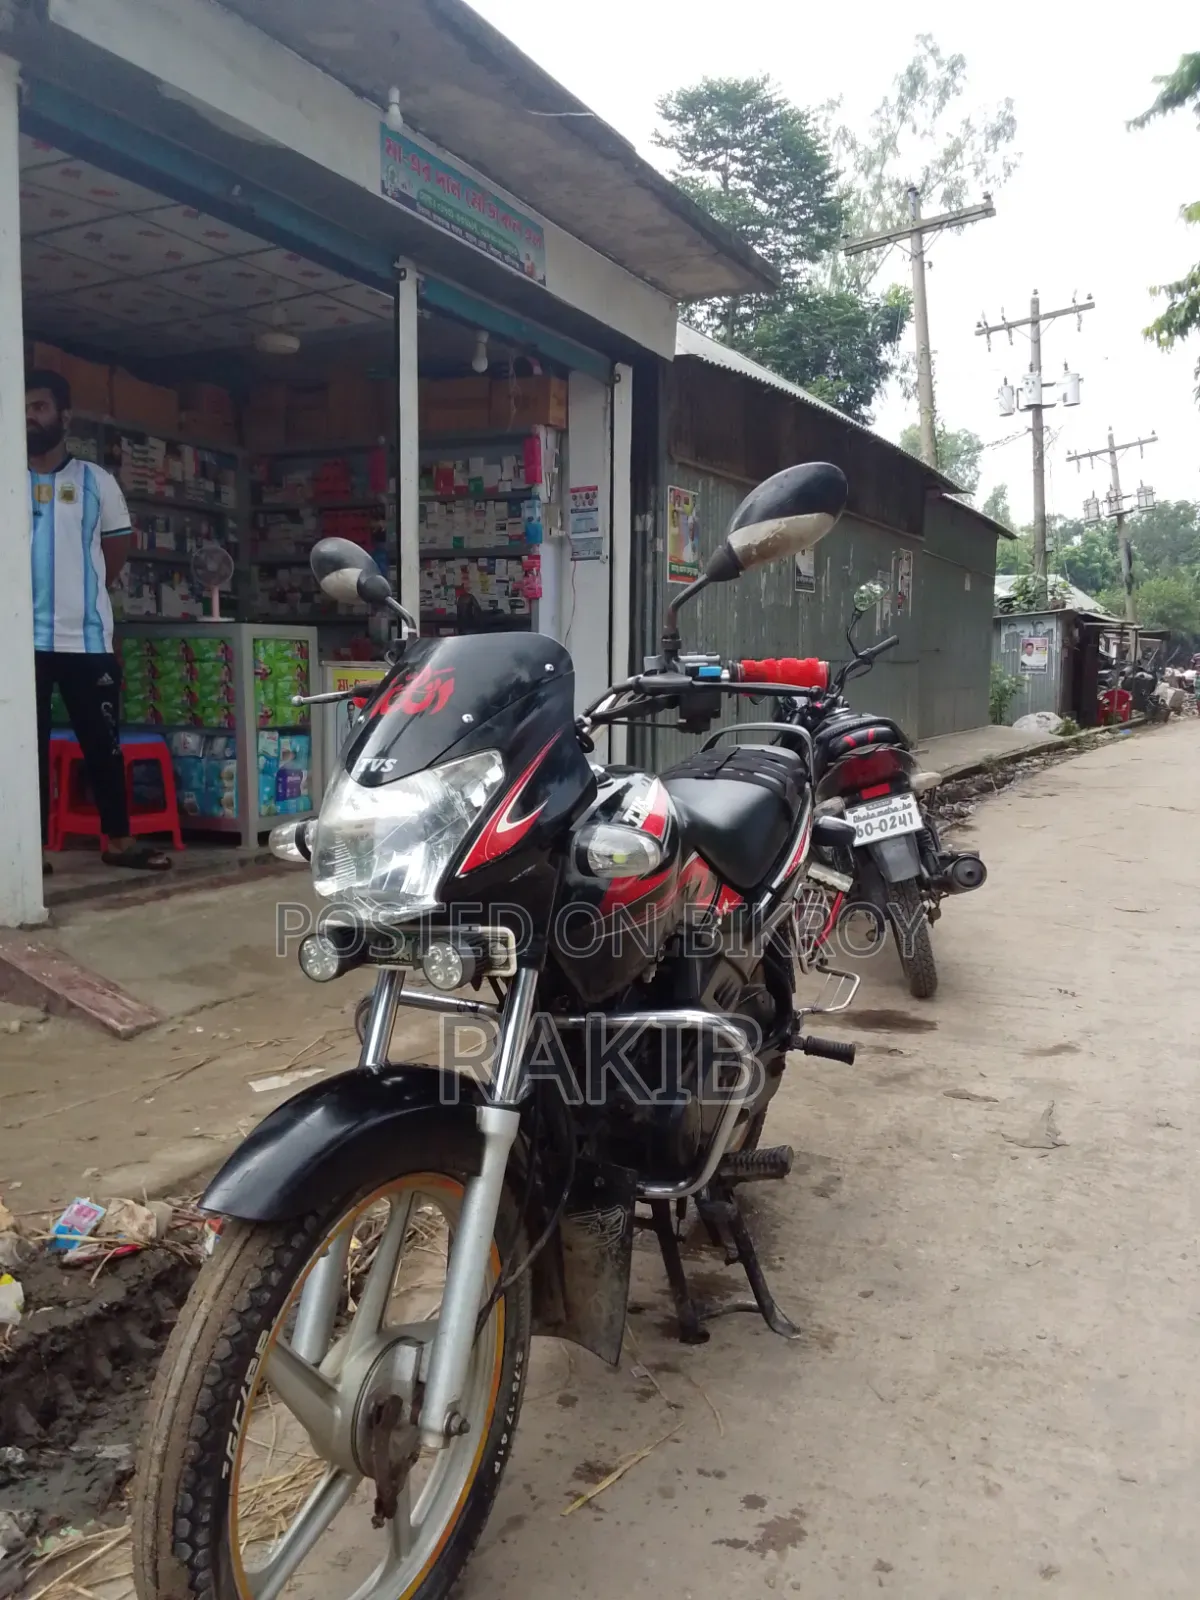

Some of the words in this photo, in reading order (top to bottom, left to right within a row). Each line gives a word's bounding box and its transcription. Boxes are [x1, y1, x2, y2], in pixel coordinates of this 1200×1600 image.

[357, 758, 398, 772] TVS
[856, 812, 913, 838] 60-0241
[506, 1351, 524, 1425] 2.75-17
